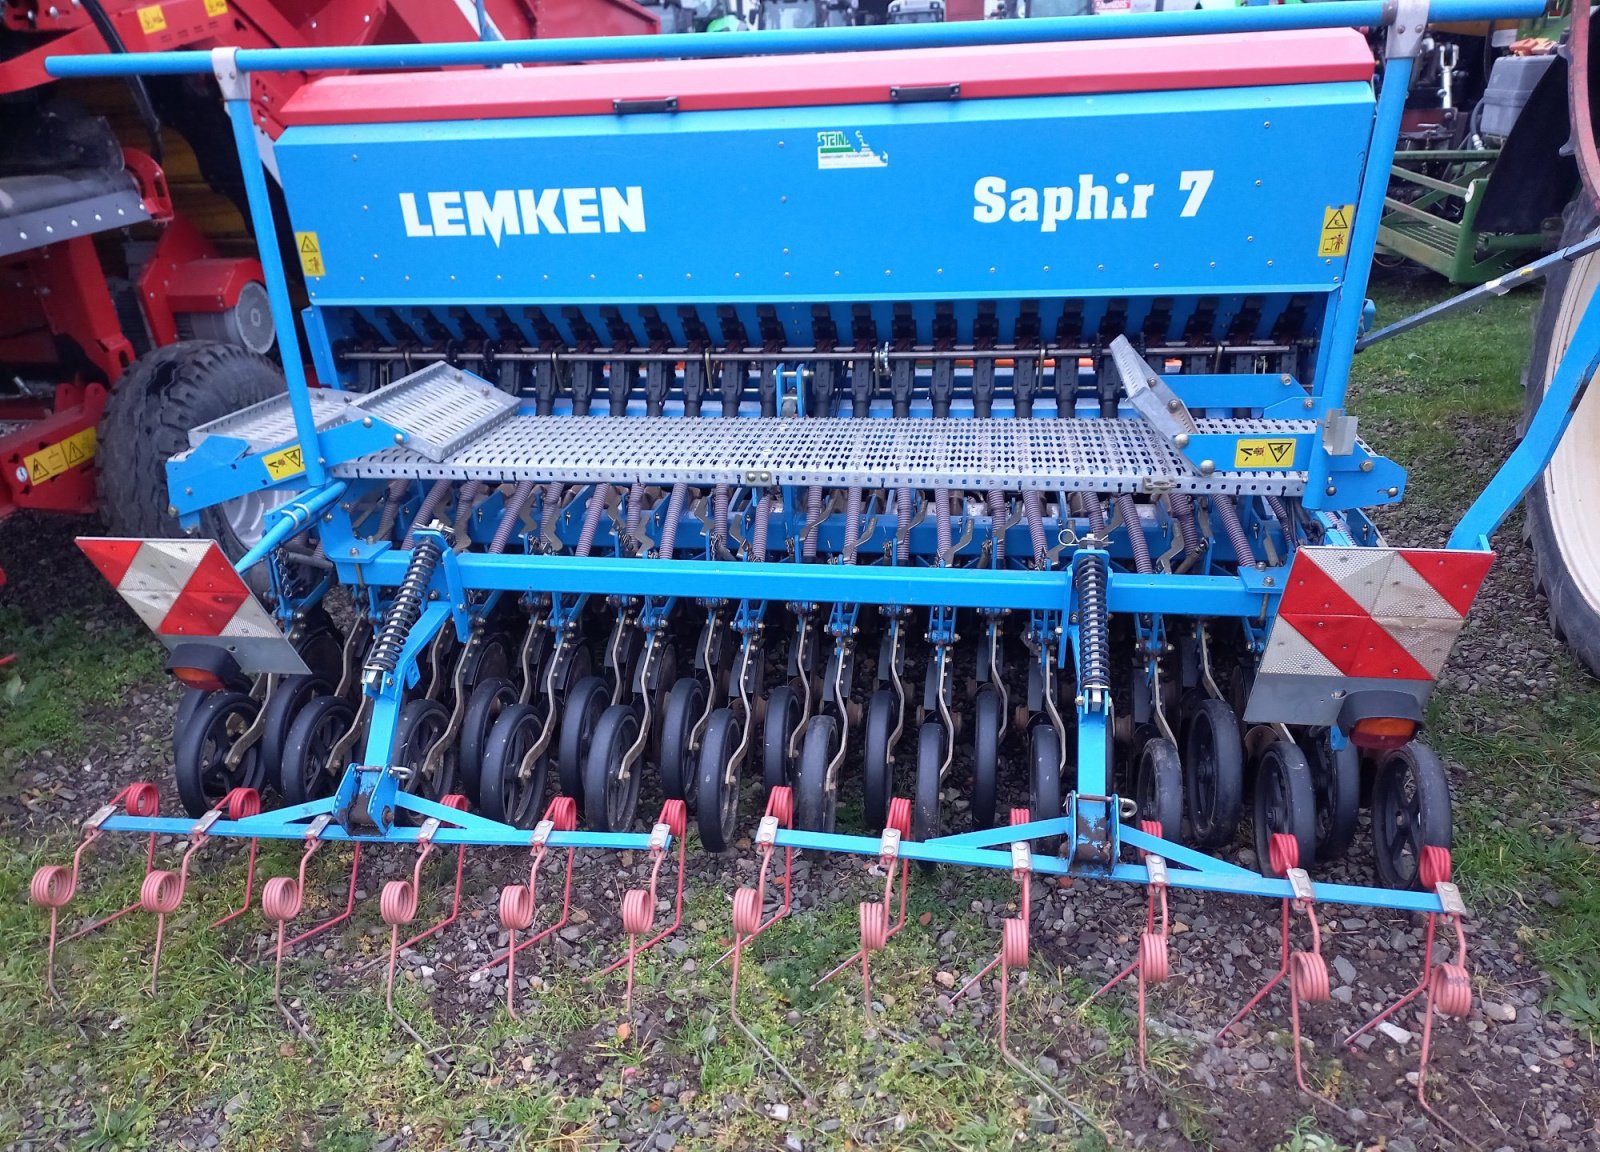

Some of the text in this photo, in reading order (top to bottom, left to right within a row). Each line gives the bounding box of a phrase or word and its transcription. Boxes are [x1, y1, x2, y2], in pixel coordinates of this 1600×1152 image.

[399, 186, 646, 249] LEMKEN
[974, 170, 1214, 232] Saphir 7
